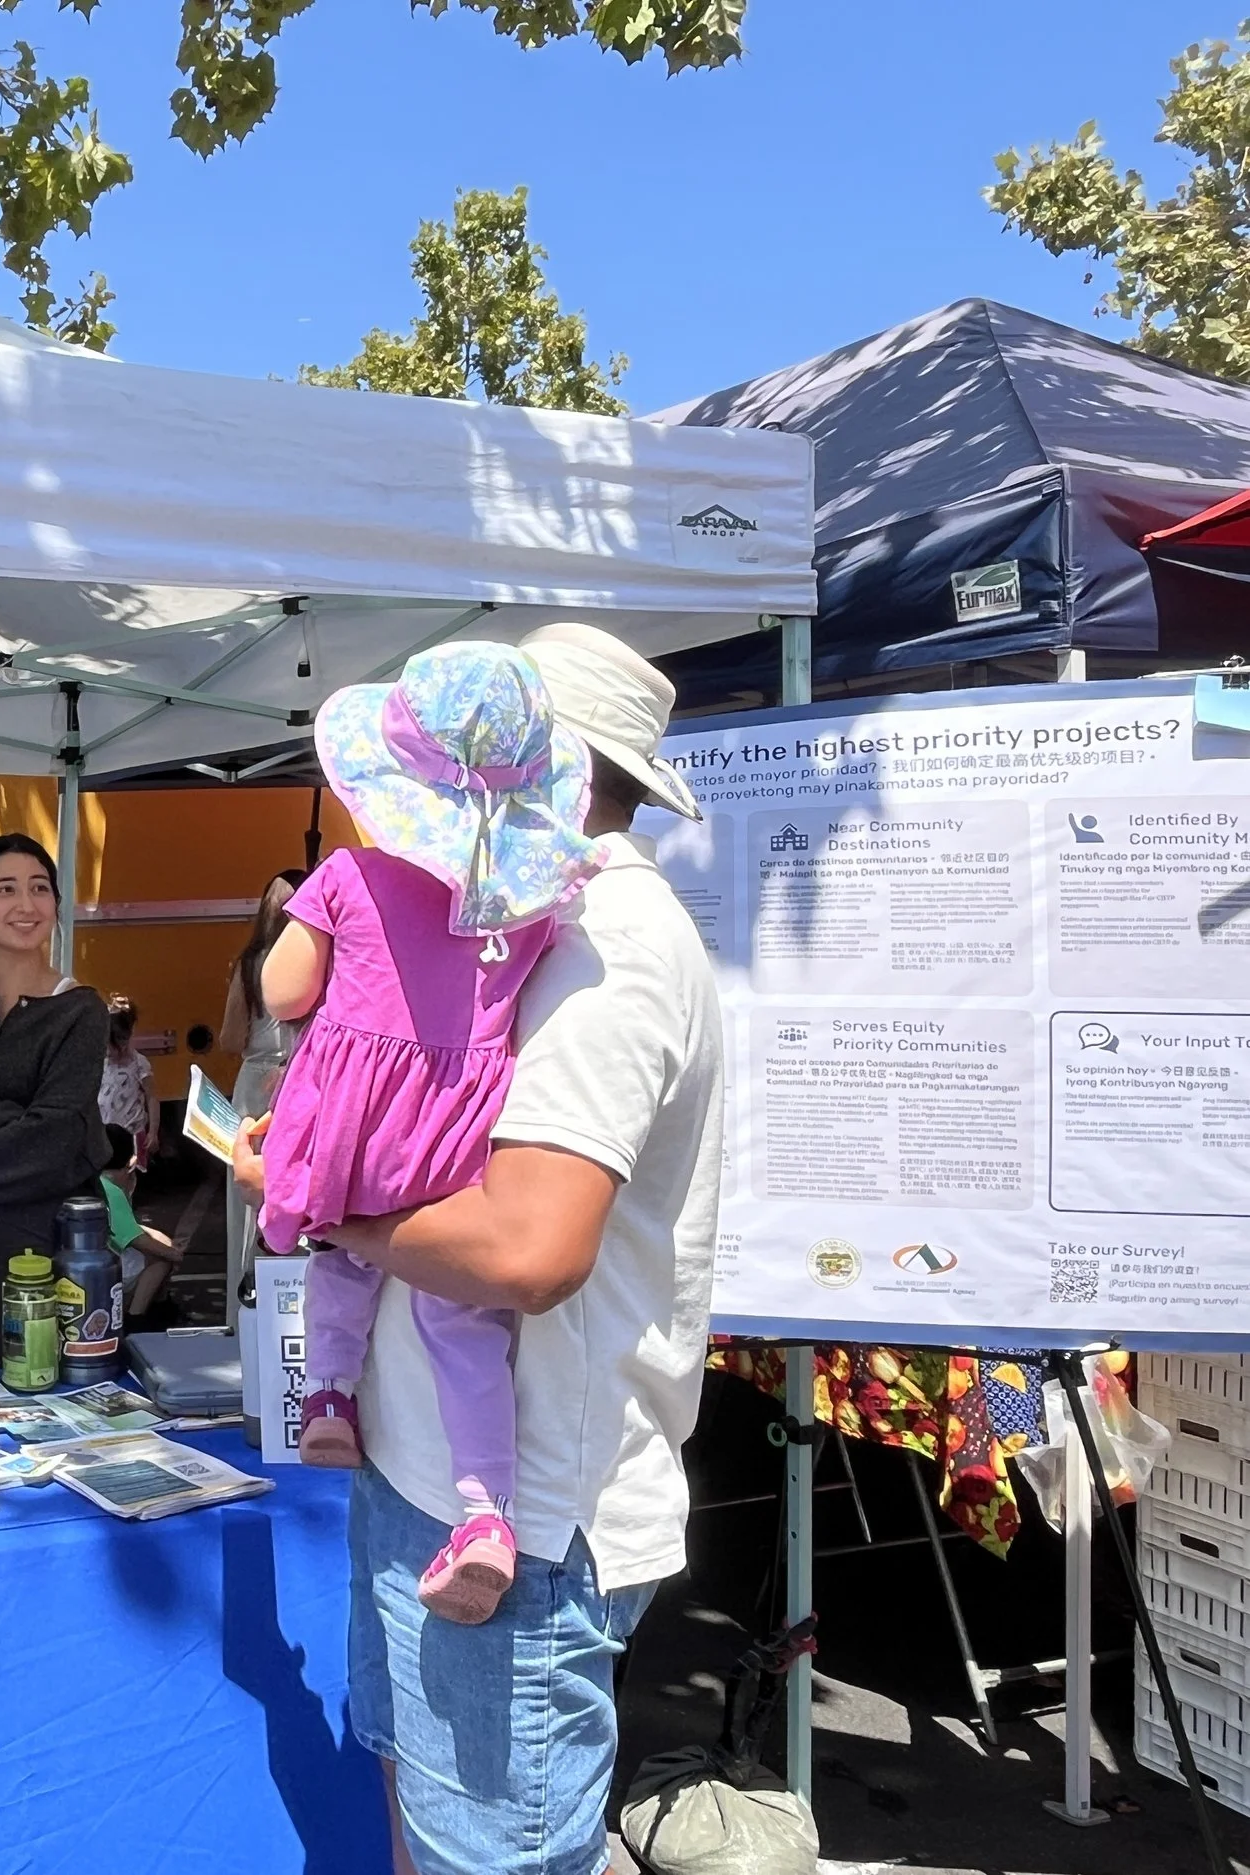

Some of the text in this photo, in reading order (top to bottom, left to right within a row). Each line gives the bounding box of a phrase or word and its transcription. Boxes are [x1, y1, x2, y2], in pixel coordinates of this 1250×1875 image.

[692, 529, 745, 537] CANOPY
[742, 745, 787, 763] the
[796, 733, 904, 760] highest
[913, 726, 1023, 754] priority
[1034, 719, 1180, 748] projects?
[729, 771, 746, 784] de
[751, 769, 796, 786] mayor
[801, 763, 877, 779] prioridad?
[711, 784, 794, 802] proyektong
[799, 784, 830, 796] may
[835, 775, 943, 794] pinakamataas
[949, 777, 967, 788] na
[973, 771, 1069, 789] prayoridad?
[828, 818, 964, 834] Near Community
[1129, 812, 1239, 828] Identified By
[828, 838, 931, 851] Destinations
[1129, 832, 1230, 847] Community
[1153, 851, 1163, 861] la
[1166, 851, 1231, 861] comunidad
[1108, 866, 1123, 875] ng
[1126, 866, 1150, 875] mga
[1213, 865, 1228, 875] ng
[832, 1020, 945, 1035] Serves Equity
[833, 1038, 1007, 1054] Priority Communities
[1141, 1034, 1181, 1047] Your
[1186, 1035, 1230, 1050] Input
[1066, 1064, 1148, 1077] Su opinión hoy
[1066, 1078, 1097, 1088] Iyong
[1100, 1078, 1176, 1089] Kontribusyon
[1048, 1242, 1185, 1260] Take our Survey!
